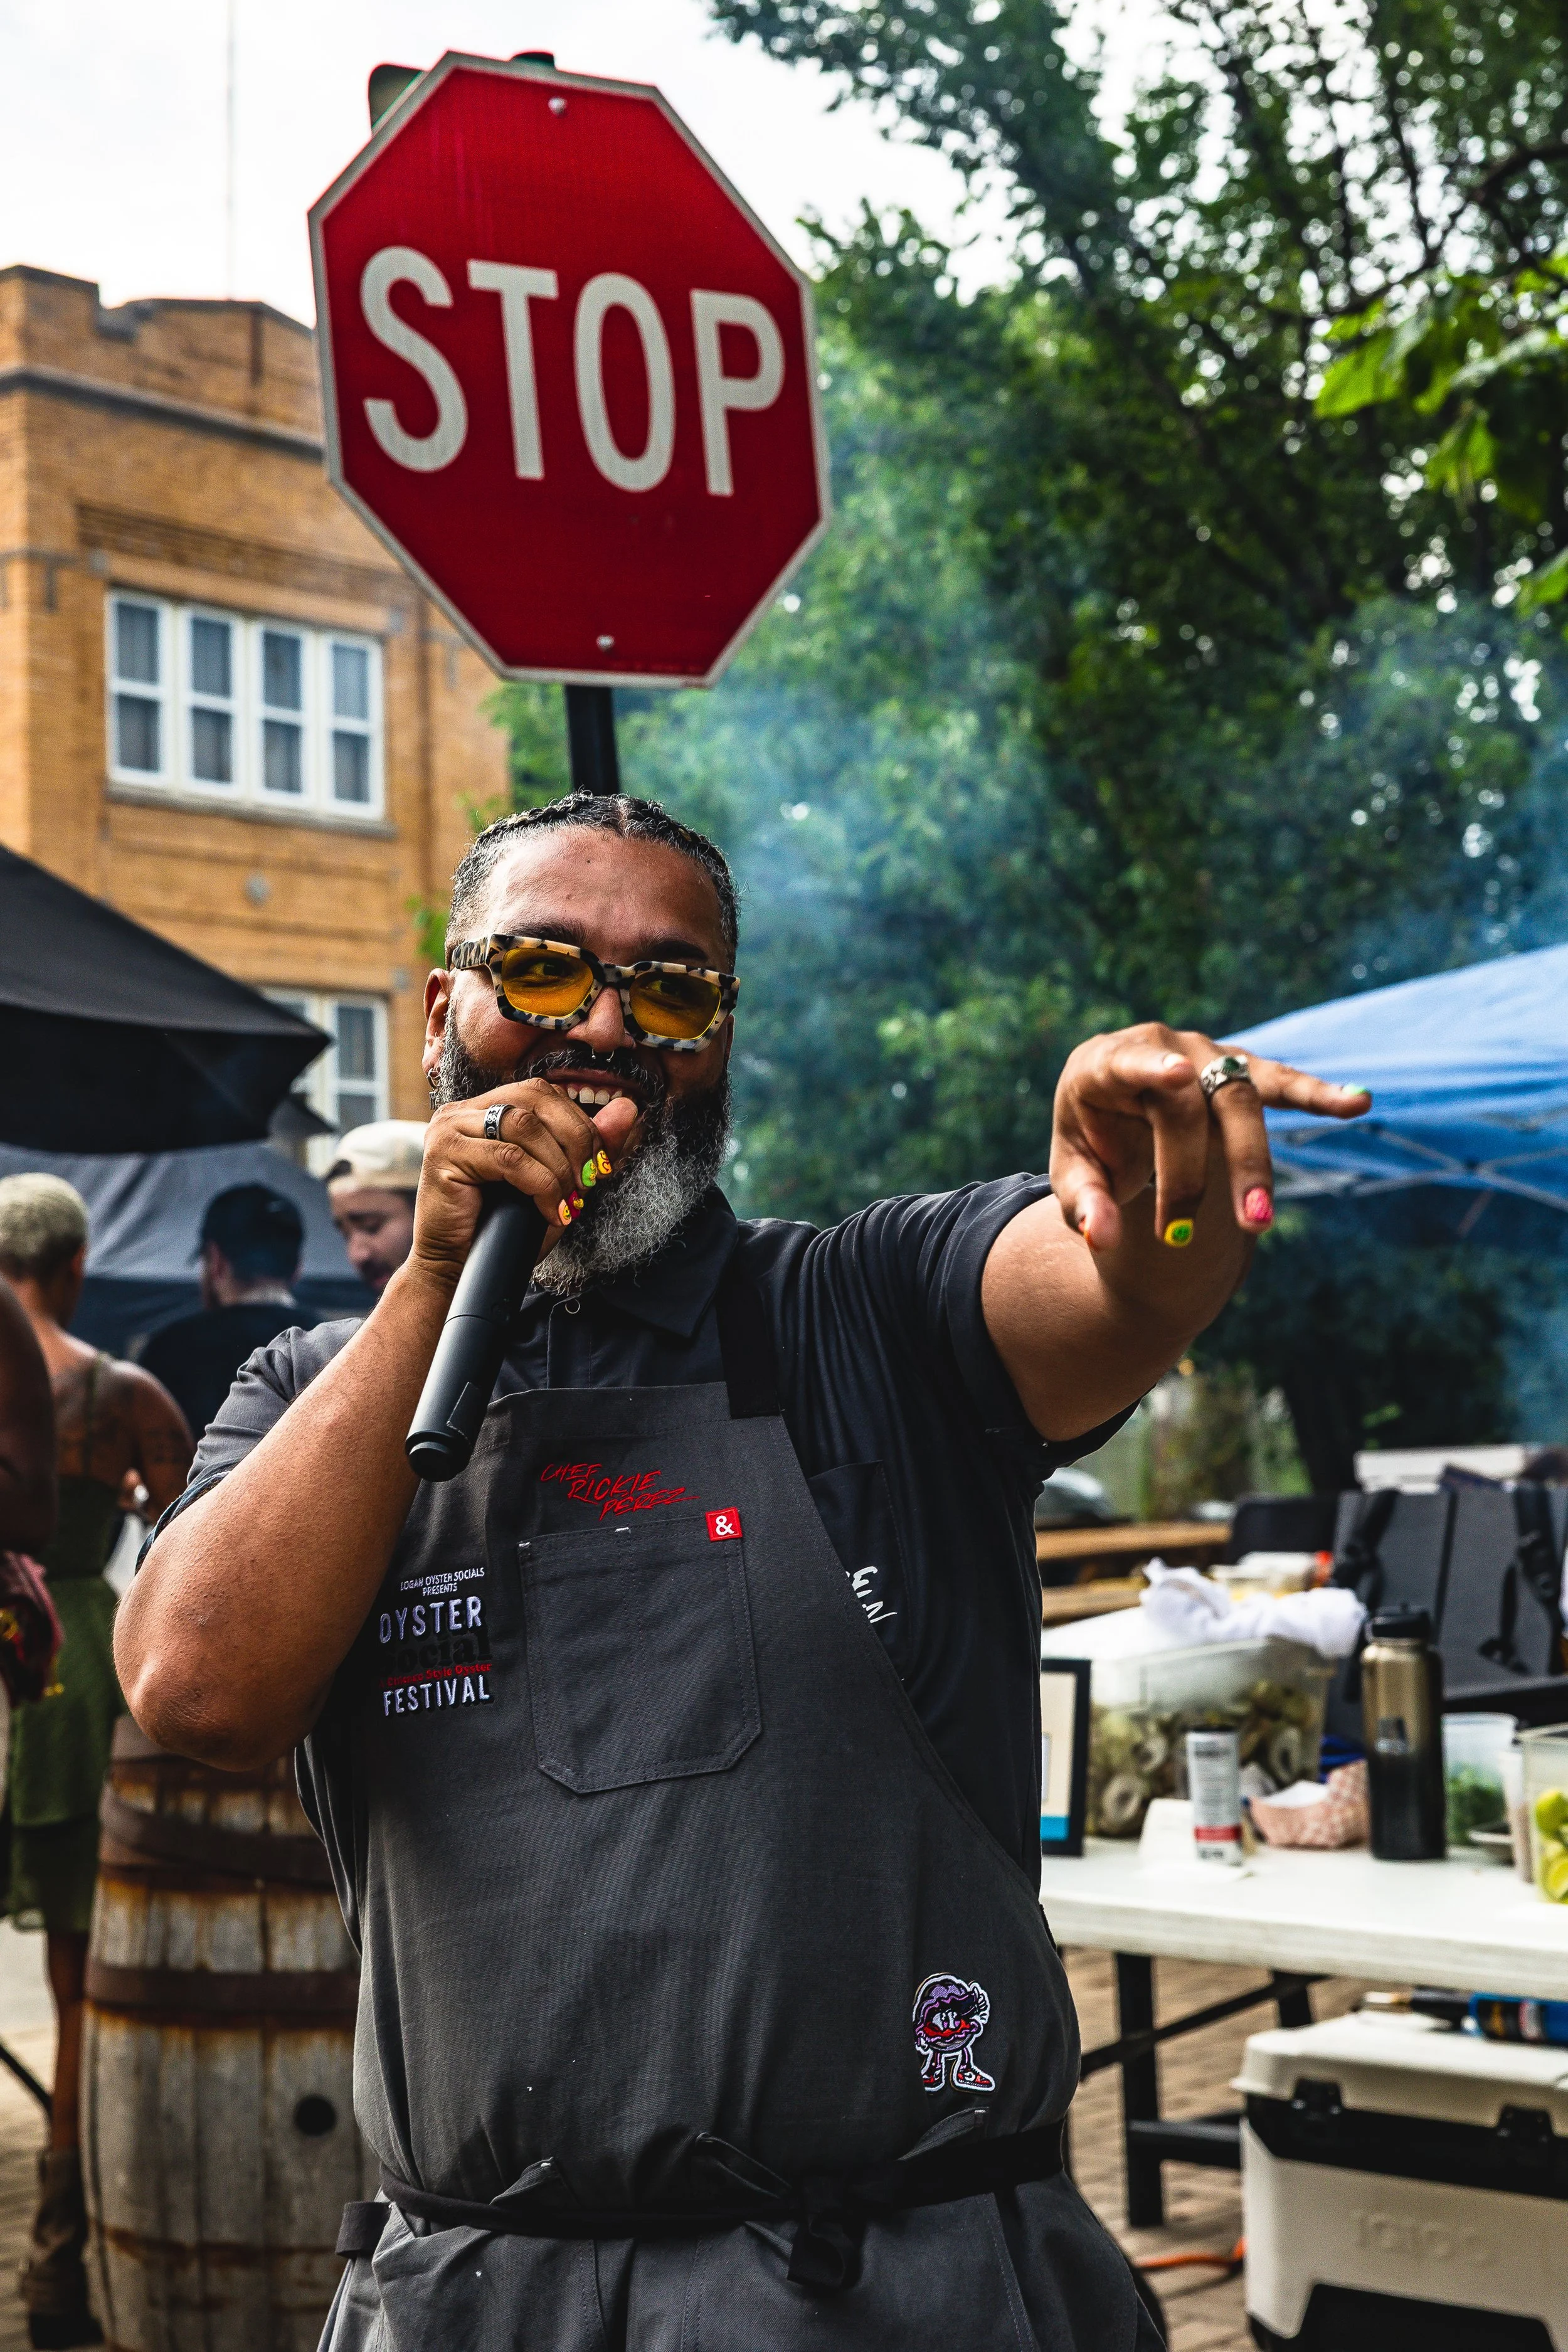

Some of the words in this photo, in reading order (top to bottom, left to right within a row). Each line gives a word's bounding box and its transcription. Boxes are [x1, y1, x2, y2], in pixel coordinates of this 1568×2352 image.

[359, 244, 786, 497] STOP
[540, 1463, 602, 1483] CHEF
[568, 1470, 661, 1505] RICKIE
[599, 1487, 701, 1521] PEREZ
[715, 1515, 734, 1535] &
[401, 1577, 423, 1591] LOGAN
[425, 1573, 452, 1586] OYSTER
[453, 1567, 485, 1582] SOCIALS
[423, 1582, 457, 1596] PRESENTS
[379, 1596, 482, 1644] OYSTER
[455, 1663, 492, 1677] Oyster
[383, 1675, 490, 1716] FESTIVAL
